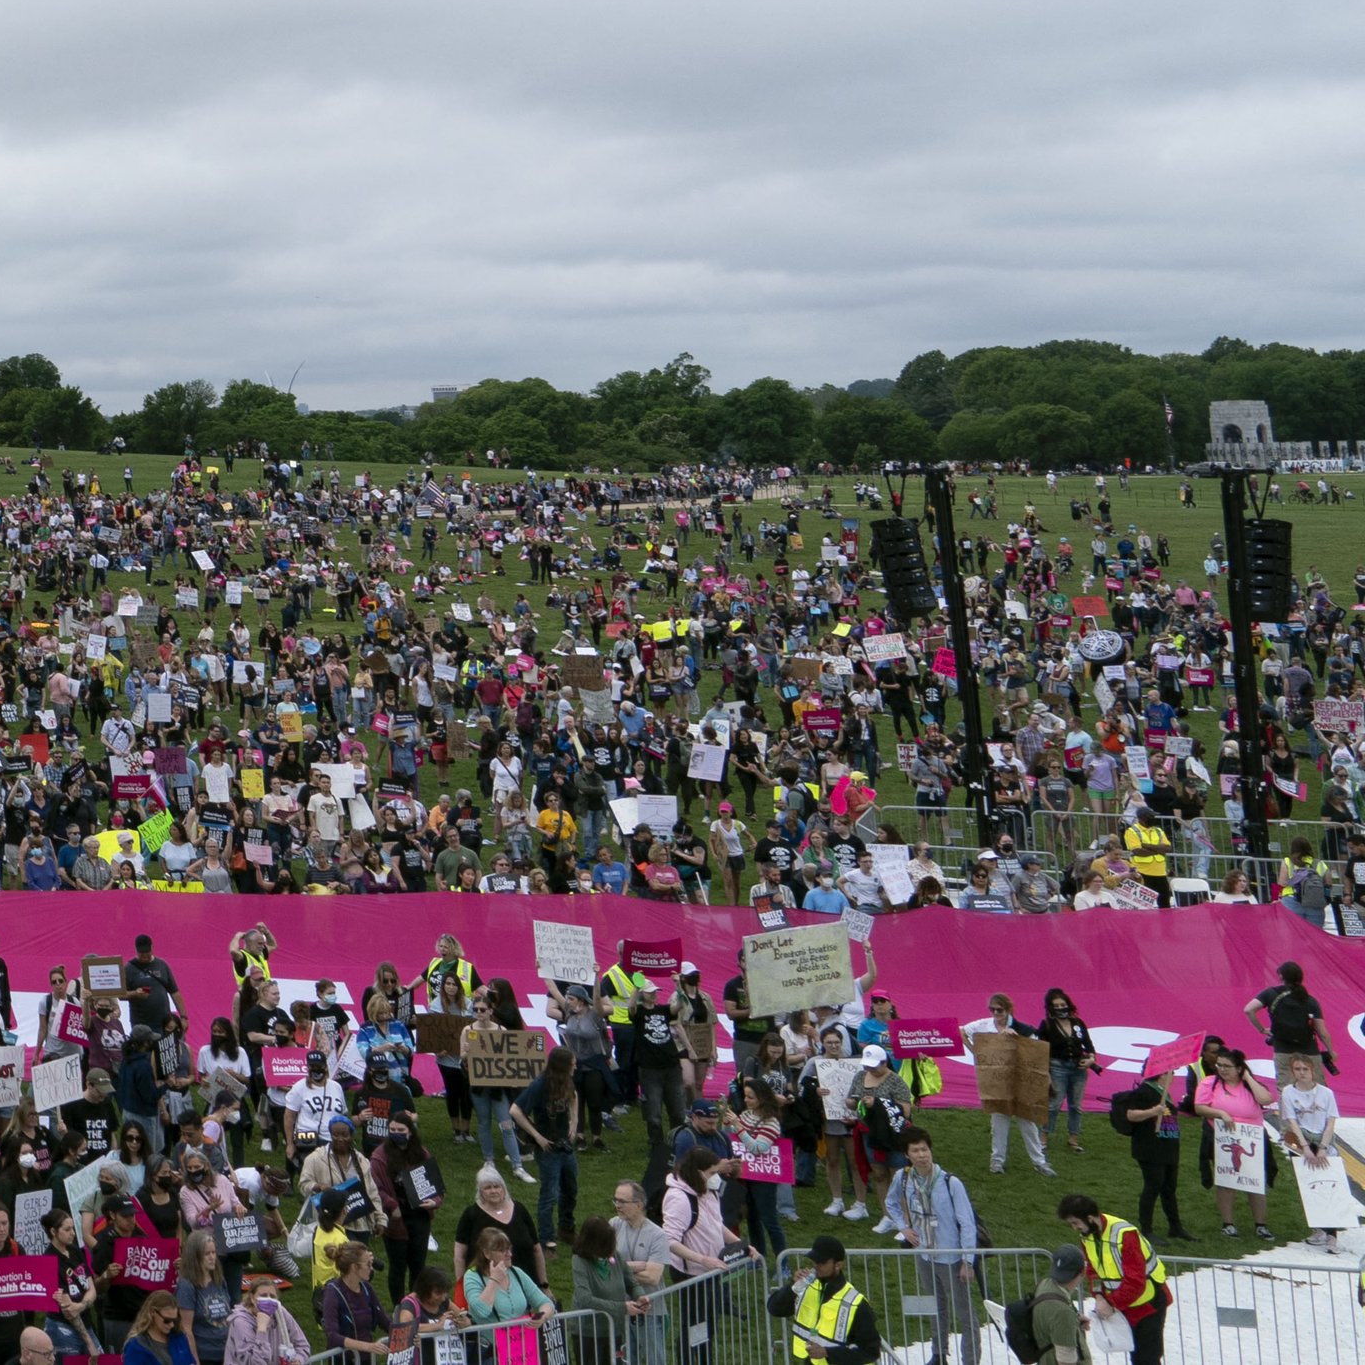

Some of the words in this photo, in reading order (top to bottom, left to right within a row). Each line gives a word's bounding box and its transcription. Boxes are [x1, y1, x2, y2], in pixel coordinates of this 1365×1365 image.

[159, 753, 180, 763] SAFE
[777, 936, 794, 947] Let
[631, 950, 663, 959] Abortion
[631, 957, 659, 965] Health
[898, 1030, 932, 1038] Abortion
[933, 1029, 940, 1037] is
[157, 1031, 175, 1050] HOW
[489, 1032, 520, 1055] WE
[899, 1037, 929, 1046] Health
[930, 1036, 954, 1045] Care.
[159, 1044, 178, 1062] DARE
[271, 1057, 304, 1066] Abortion
[818, 1059, 833, 1072] MY
[272, 1064, 300, 1073] Health
[472, 1058, 546, 1080] DISSENT
[305, 1095, 345, 1115] 1973
[86, 1130, 103, 1139] THE
[1240, 1125, 1261, 1140] ARE
[87, 1139, 108, 1150] FEDS
[409, 1166, 426, 1179] STAND
[23, 1196, 49, 1211] GIRLS
[233, 1215, 256, 1227] BODIES
[126, 1246, 158, 1260] BANS
[125, 1257, 147, 1267] OFF
[147, 1259, 170, 1271] OUR
[24, 1272, 32, 1281] is
[124, 1266, 166, 1282] BODIES
[18, 1283, 47, 1292] Care.
